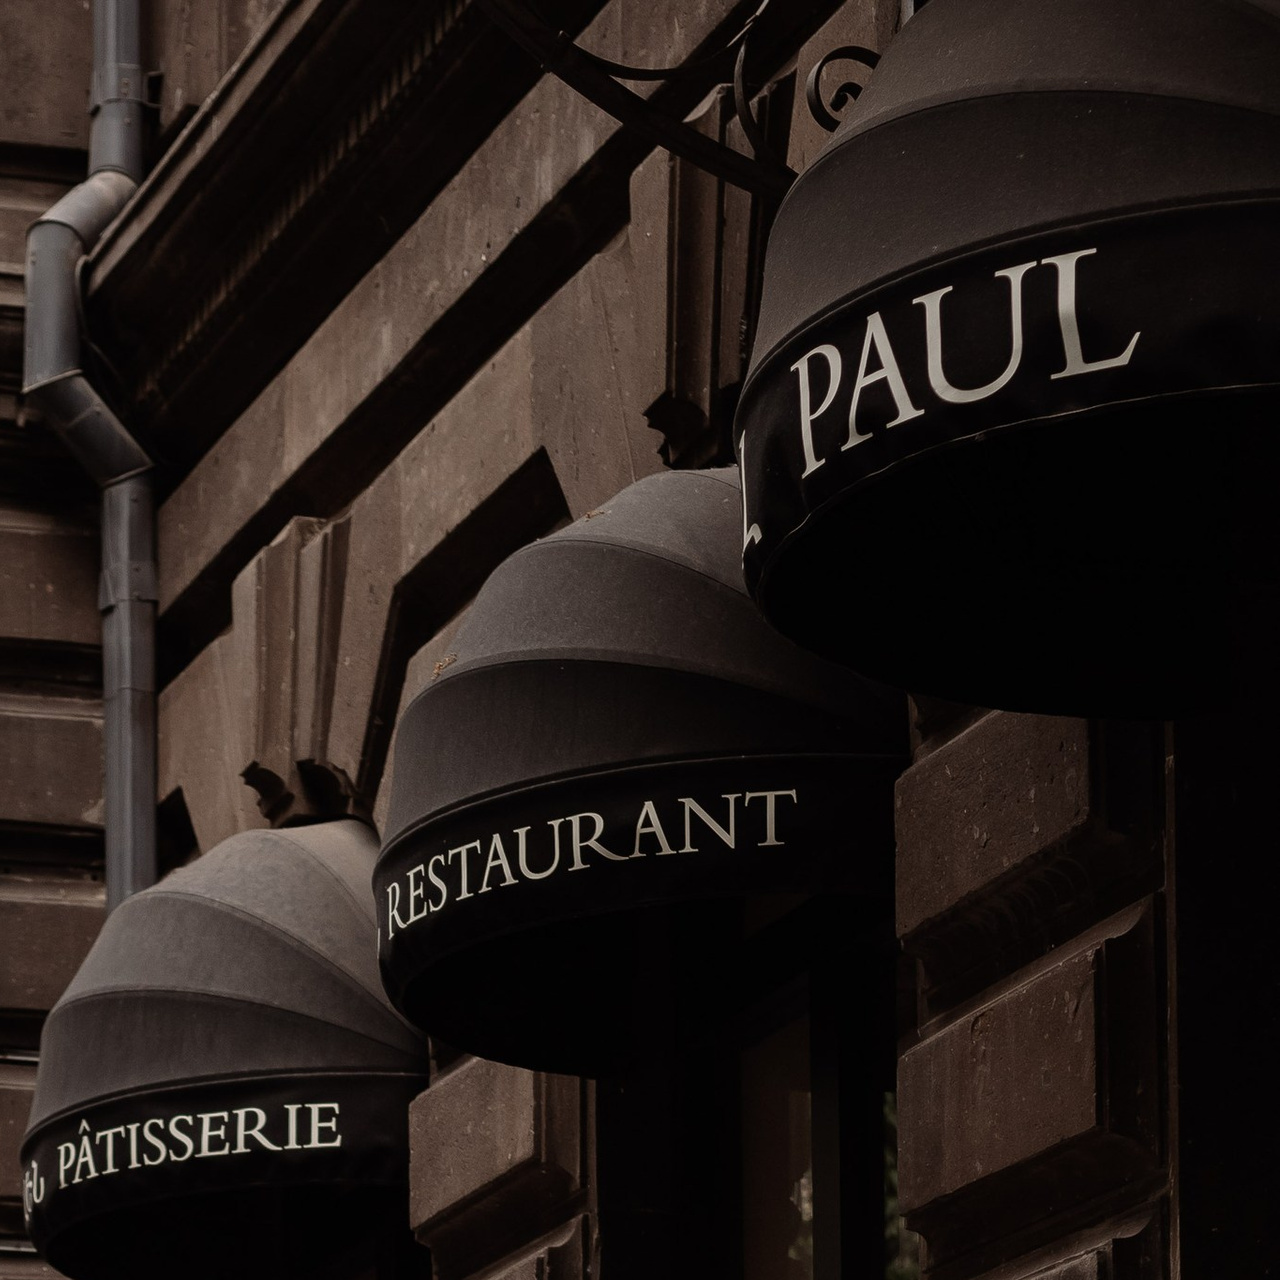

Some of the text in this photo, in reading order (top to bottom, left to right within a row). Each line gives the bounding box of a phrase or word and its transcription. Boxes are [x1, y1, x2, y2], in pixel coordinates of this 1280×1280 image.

[790, 247, 1141, 479] PAUL
[386, 789, 797, 940] RESTAURANT
[57, 1102, 342, 1189] PÂTISSERIE
